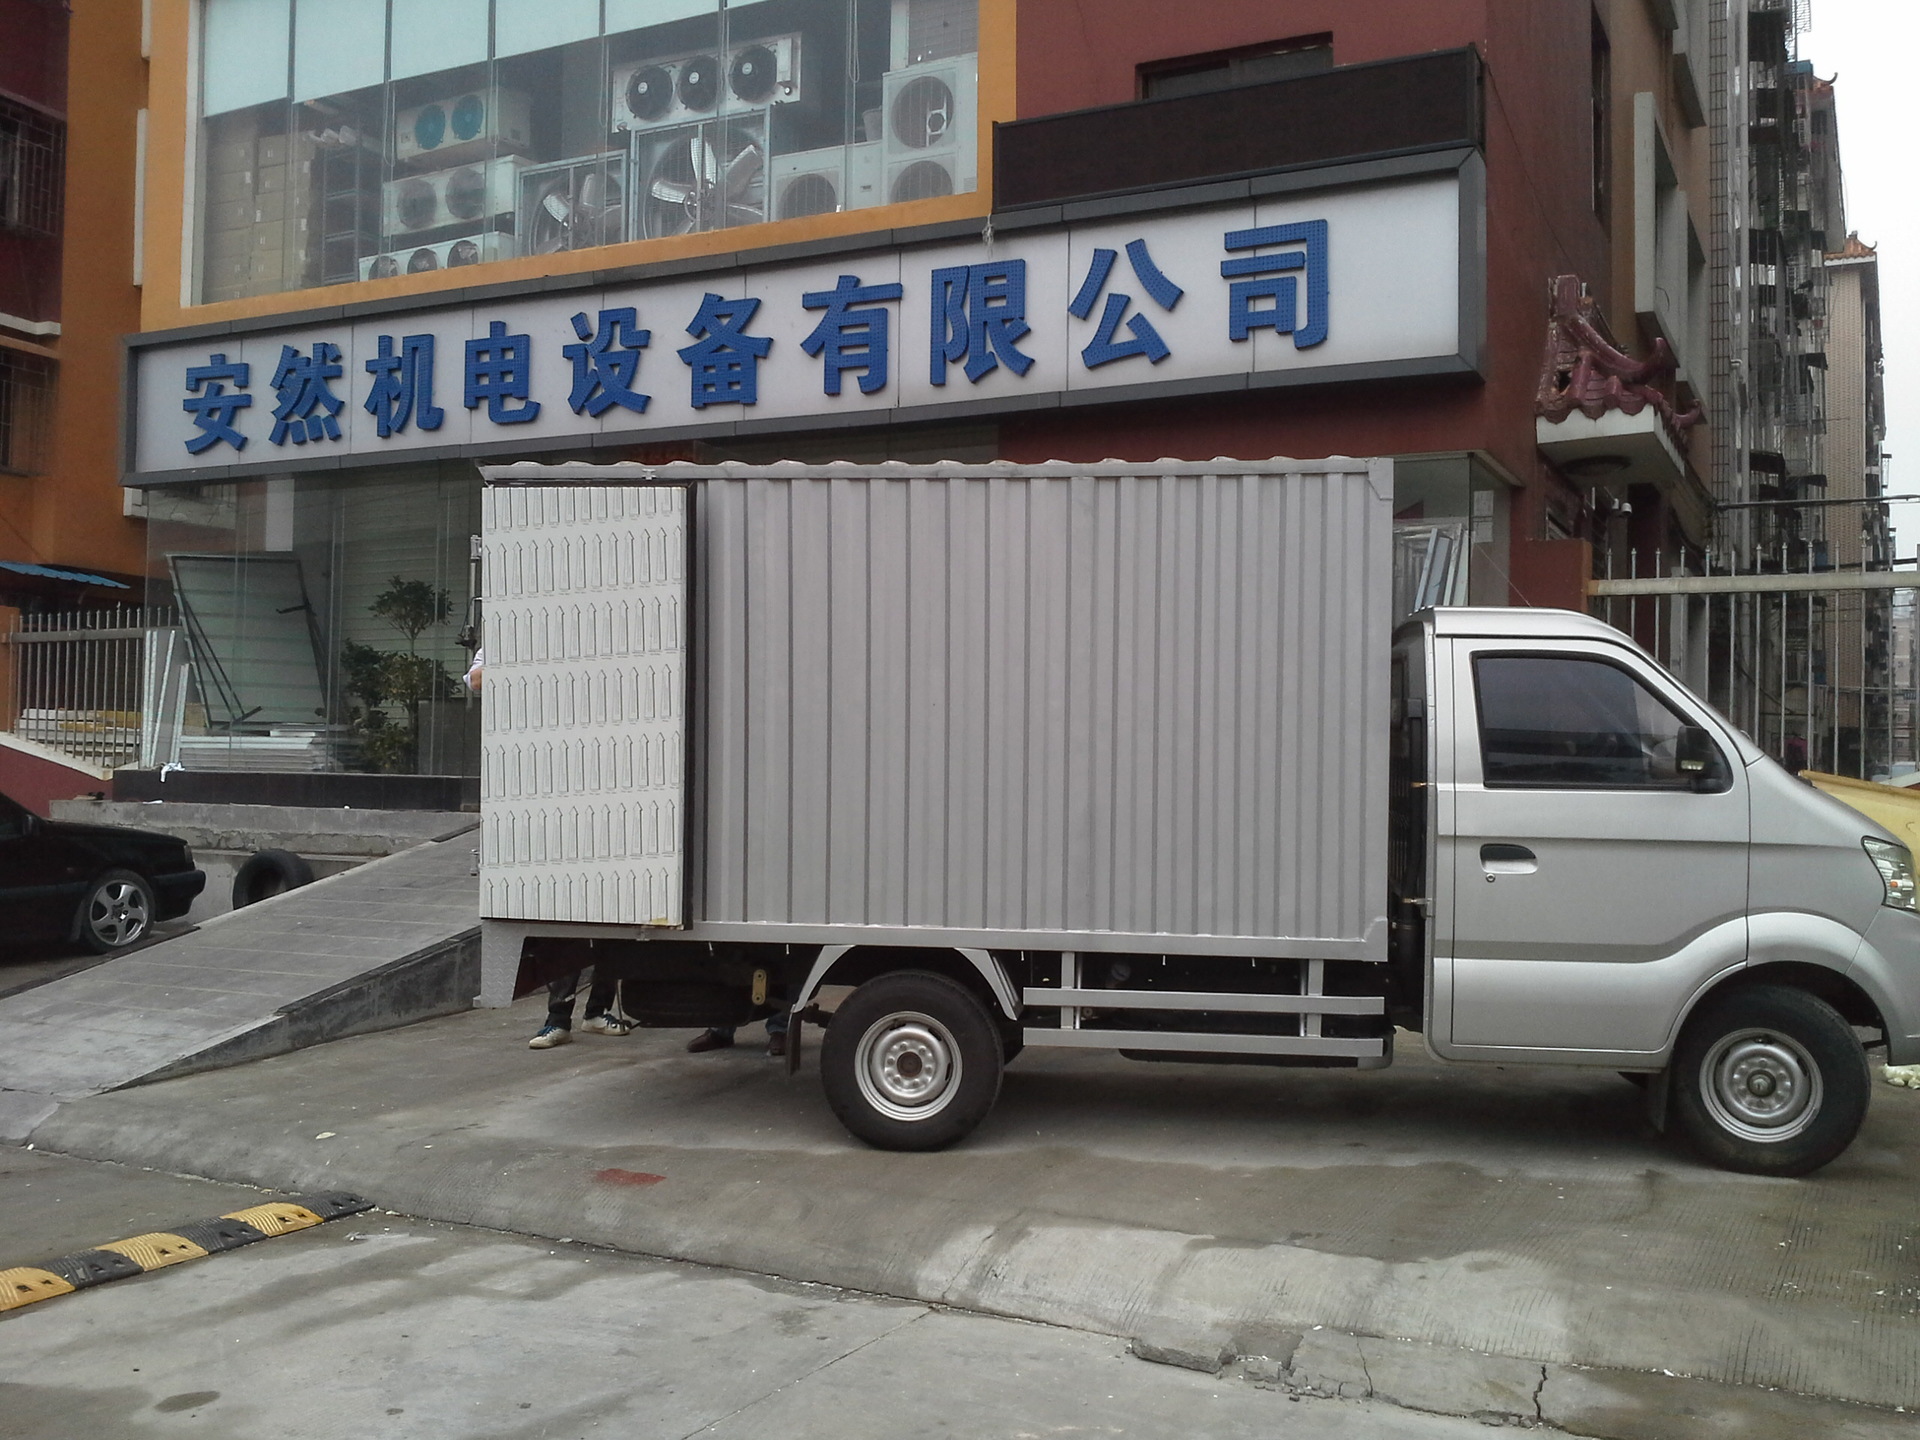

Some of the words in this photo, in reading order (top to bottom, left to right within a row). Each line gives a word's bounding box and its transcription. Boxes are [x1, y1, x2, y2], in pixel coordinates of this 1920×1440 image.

[183, 219, 1330, 454] 安然机电设备有限公司
